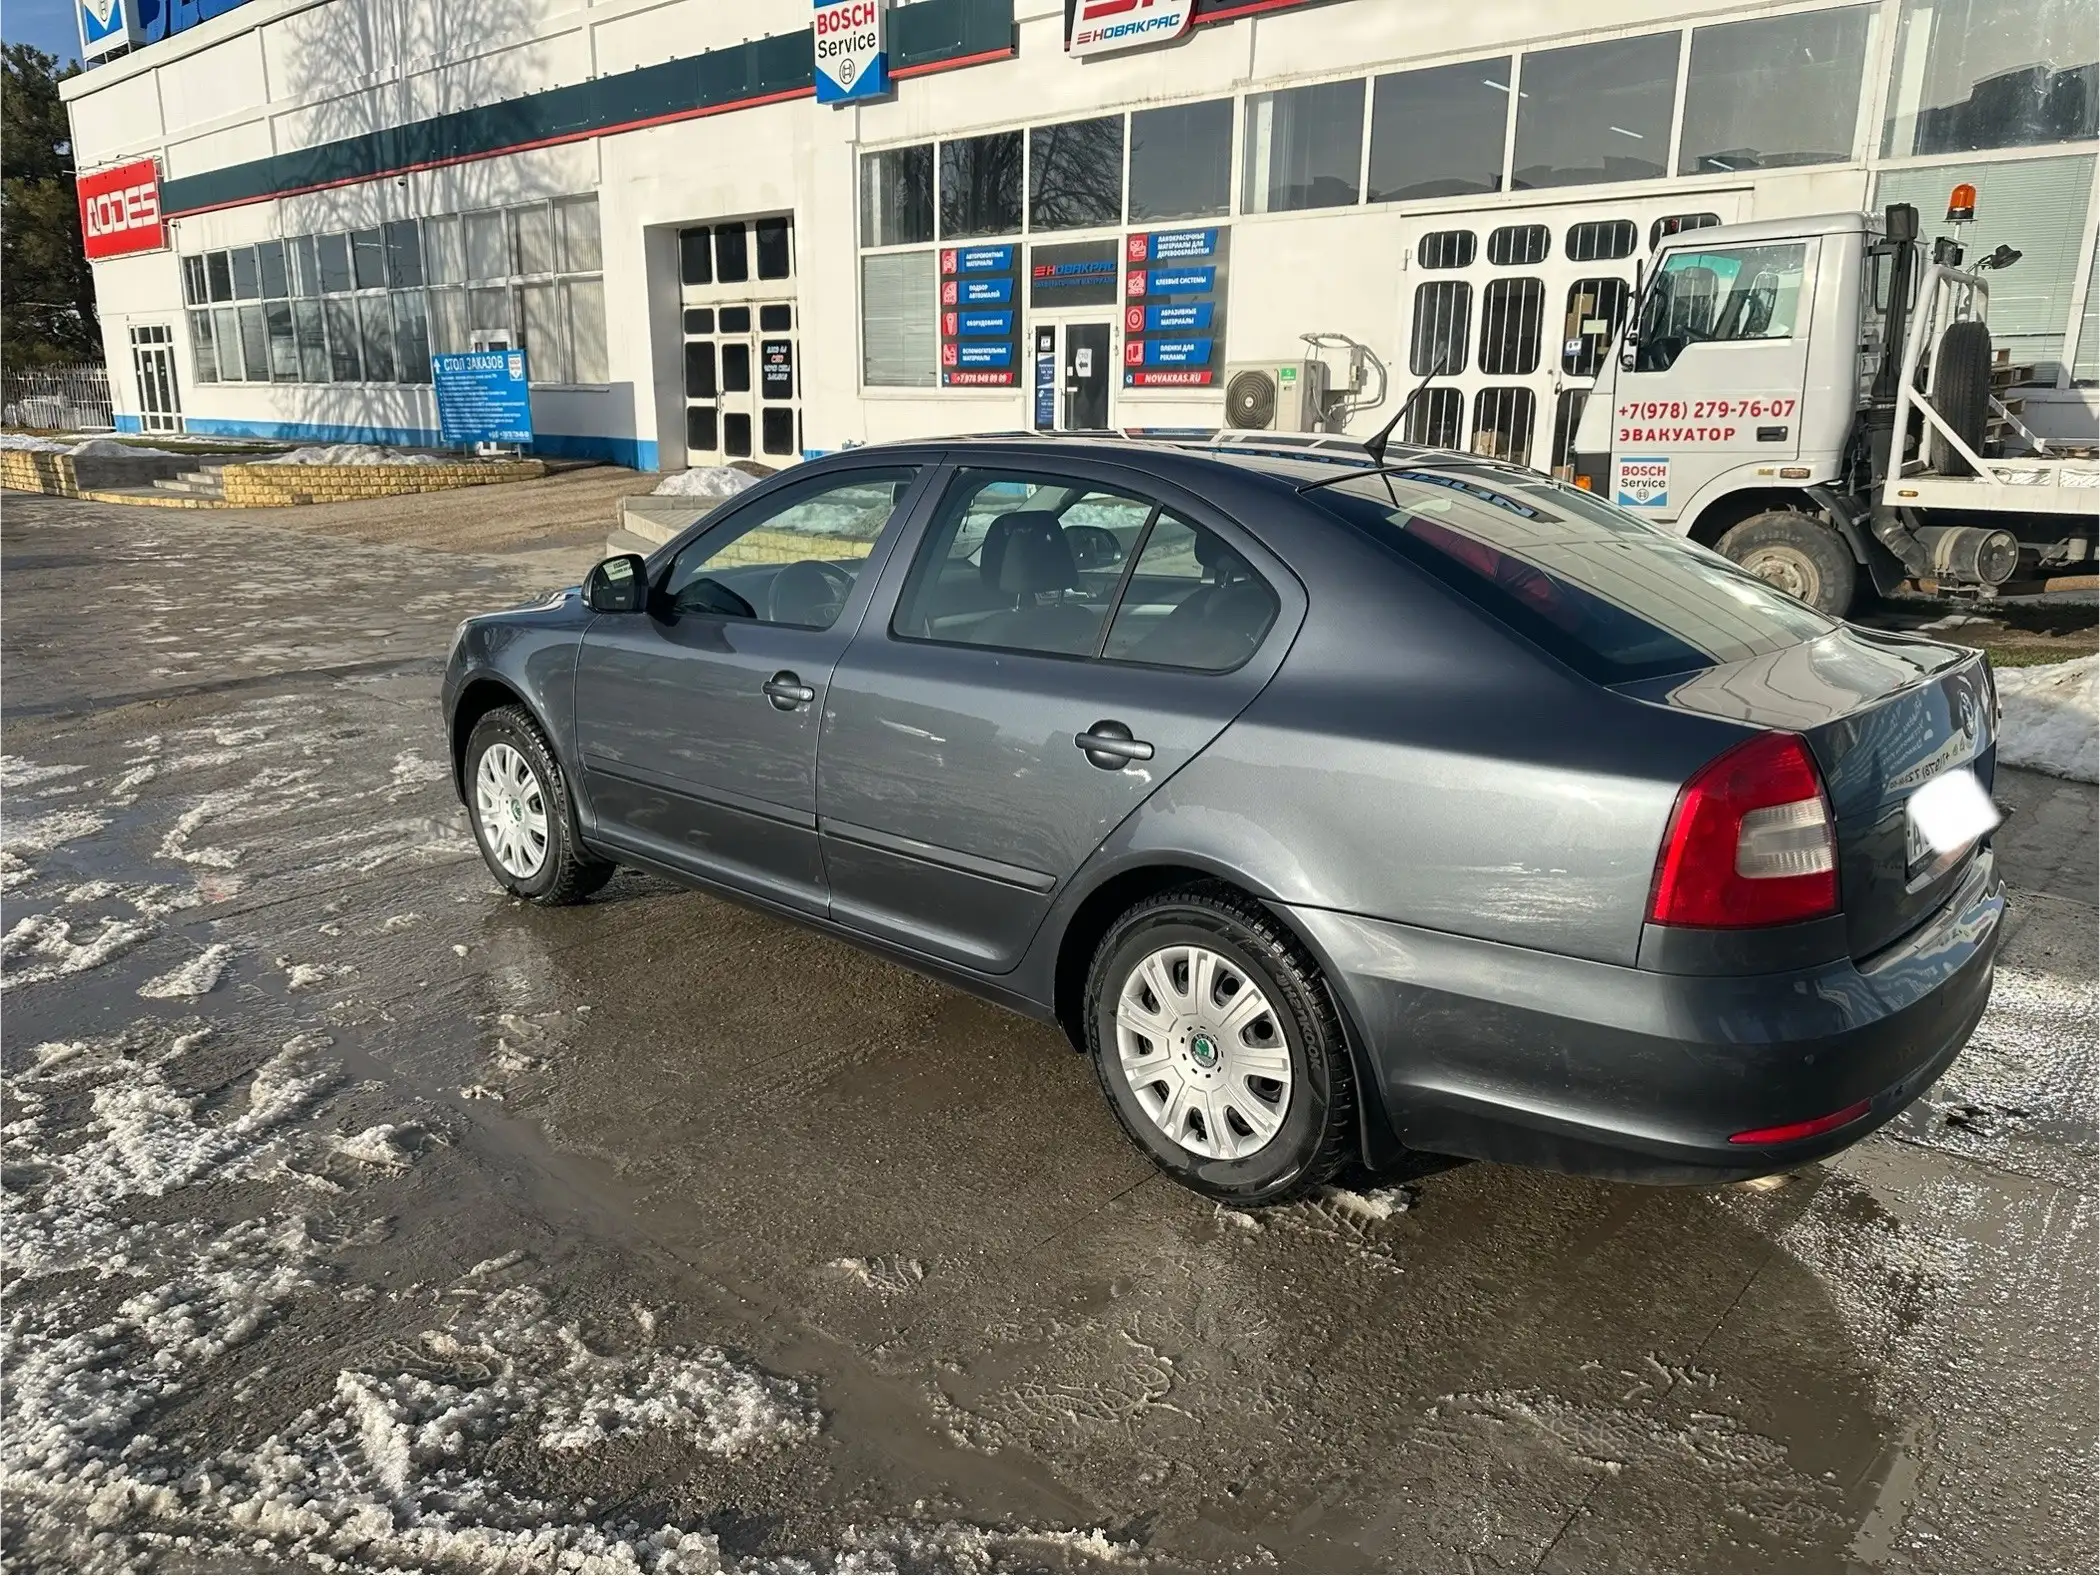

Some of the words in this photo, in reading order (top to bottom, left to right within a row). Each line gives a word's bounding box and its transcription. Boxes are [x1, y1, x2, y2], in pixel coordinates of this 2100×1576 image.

[817, 1, 875, 35] BOSCH
[1092, 13, 1181, 42] НОВАКРАС
[817, 30, 876, 59] Service
[86, 181, 160, 238] AODES
[1157, 232, 1206, 243] ЛАКОКРАСОЧНЫЕ
[1157, 241, 1191, 250] МАТЕРИАЛЫ
[1191, 240, 1204, 248] ДЛЯ
[1157, 247, 1210, 259] ДЕРЕВООБРАБОТКИ
[1155, 278, 1179, 286] КЛЕЕВЫЕ
[1179, 276, 1207, 284] СИСТЕМЫ
[968, 284, 989, 292] ПОДБОР
[968, 290, 1000, 299] АВТОЭМАЛЕЙ
[1160, 308, 1197, 317] АБРАЗИВНЫЕ
[966, 319, 1003, 327] ОБОРУДОВАНИЕ
[1160, 317, 1194, 326] МАТЕРИАЛЫ
[962, 347, 1007, 355] ВСПОМОГАТЕЛЬНЫЕ
[1182, 343, 1195, 353] ДЛЯ
[443, 357, 465, 371] СТОЛ
[466, 355, 504, 370] ЗАКАЗОВ
[1144, 373, 1202, 383] NOVAKRAS.RU
[1618, 401, 1688, 421] +7(978)
[1693, 400, 1796, 419] 279-76-07
[1619, 427, 1736, 442] ЭВАКУАТОР
[1621, 466, 1667, 477] BOSCH
[1621, 477, 1666, 488] Service
